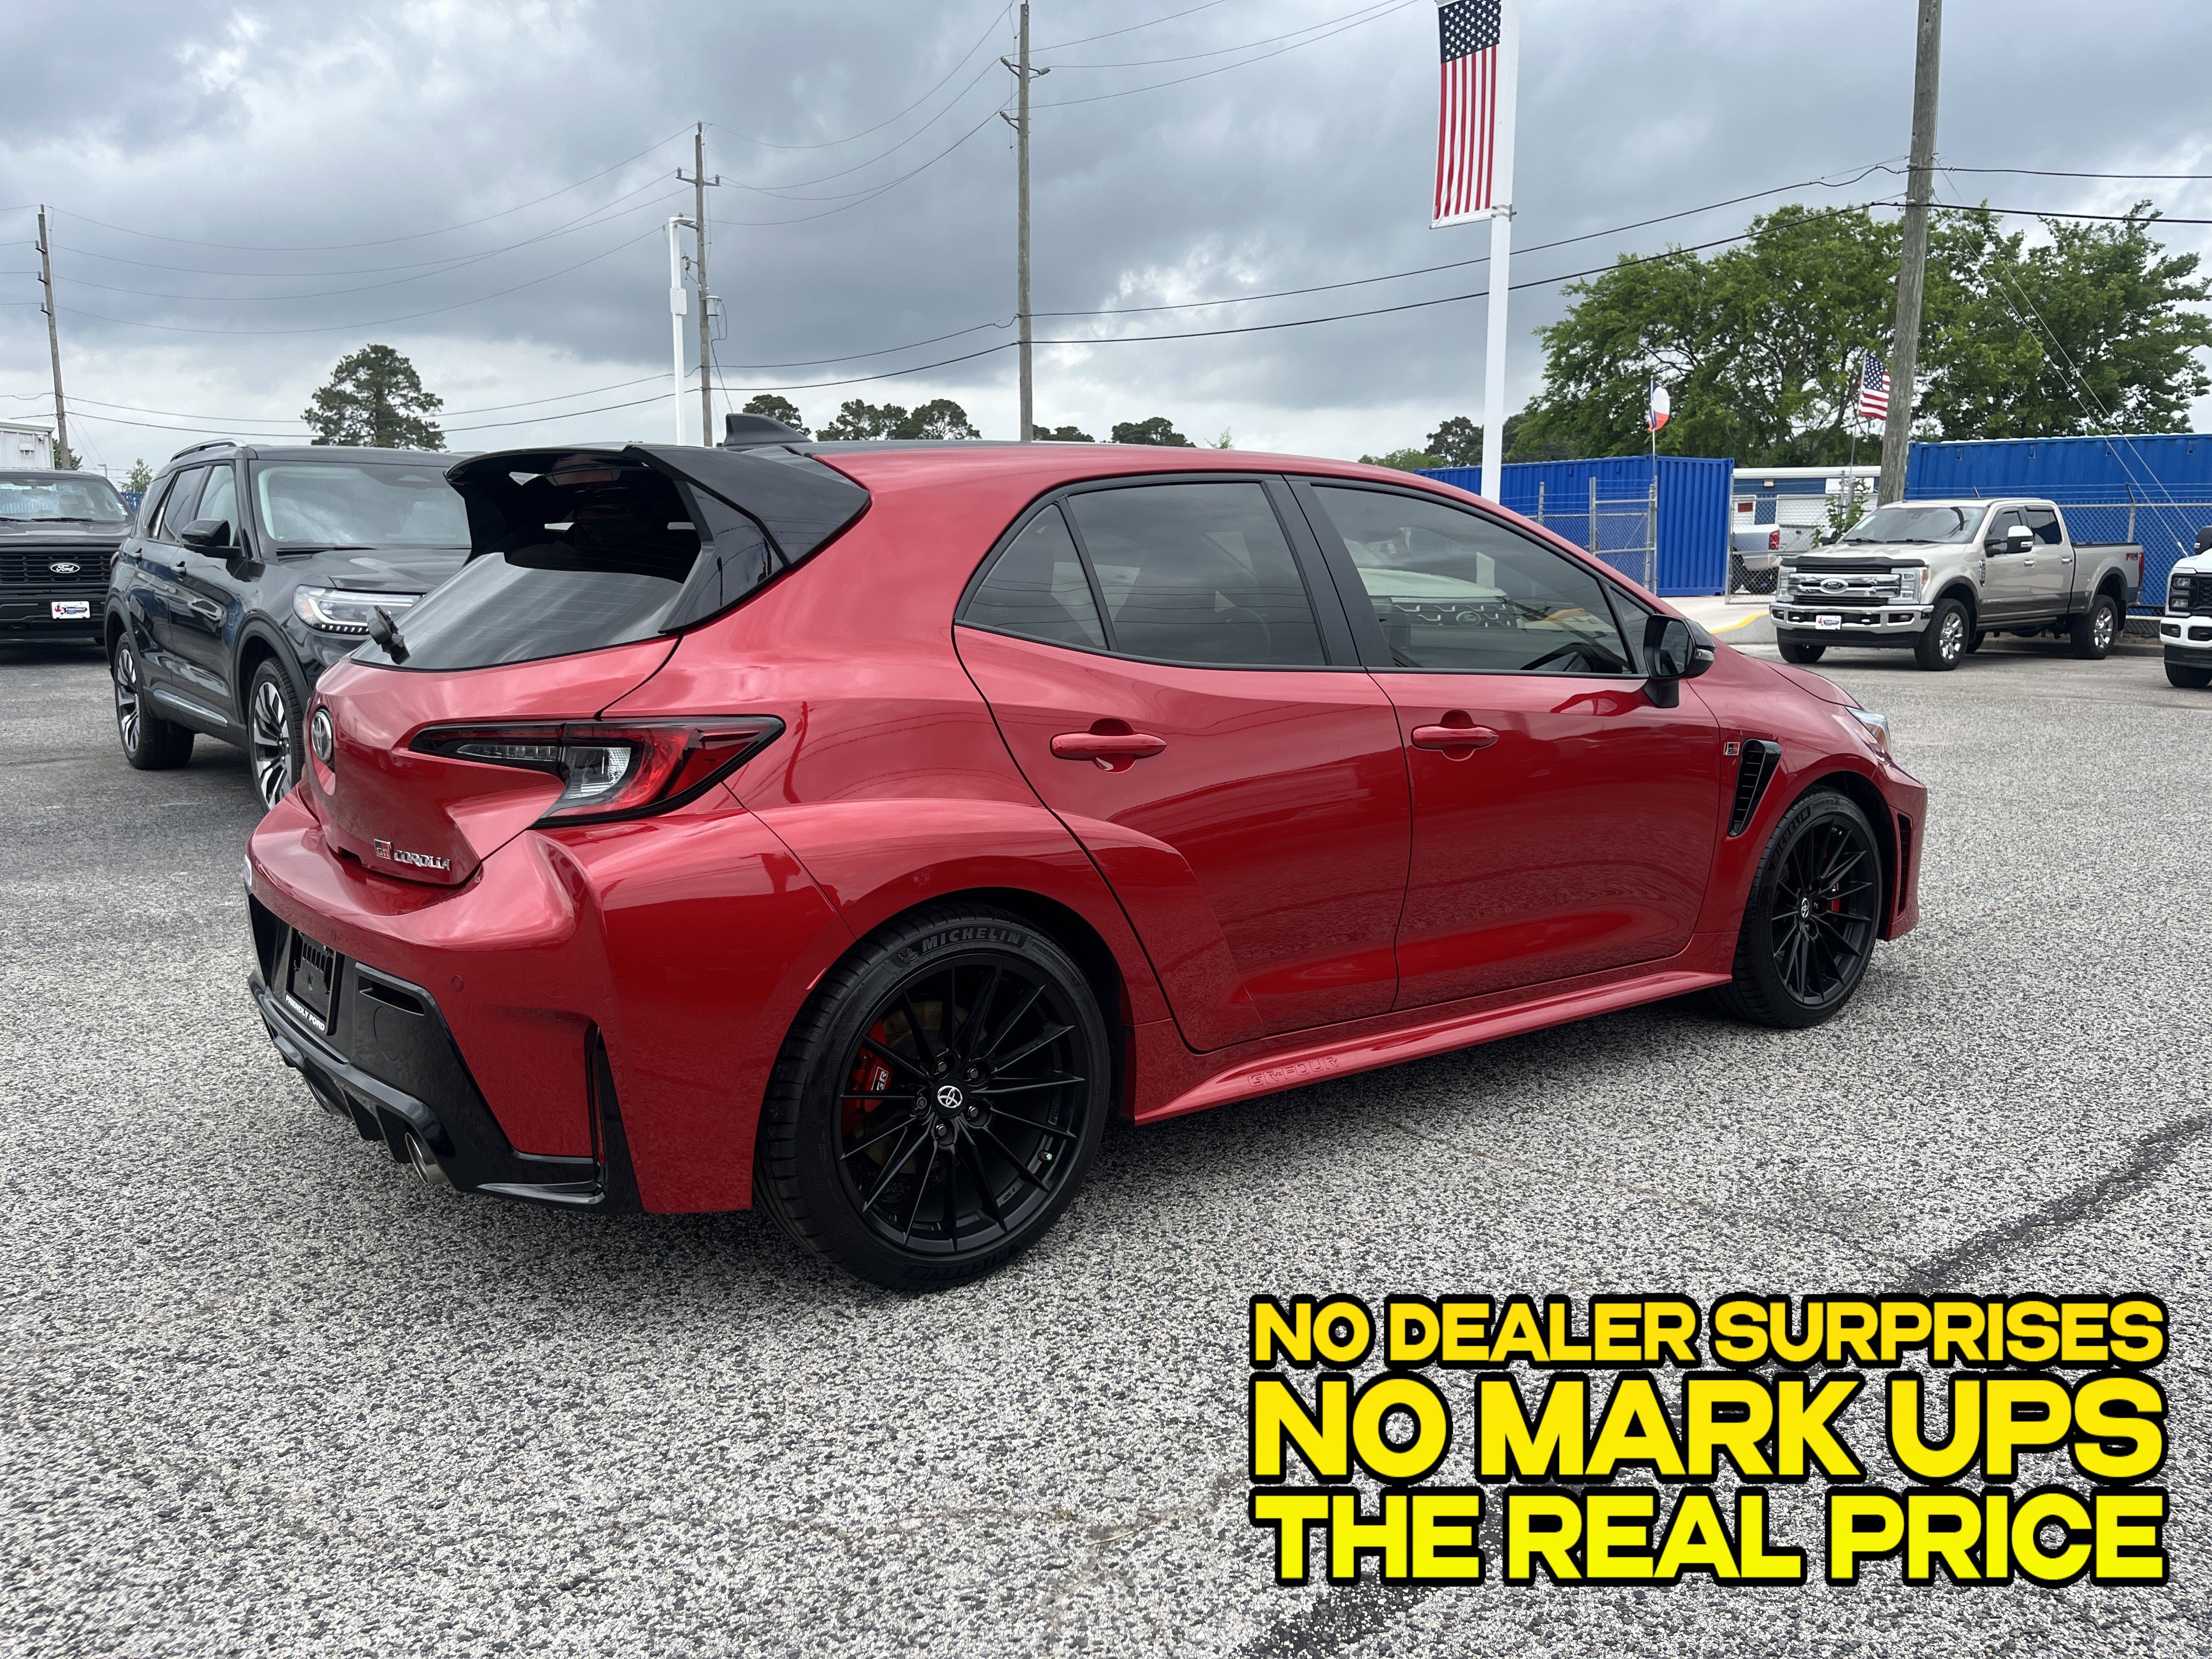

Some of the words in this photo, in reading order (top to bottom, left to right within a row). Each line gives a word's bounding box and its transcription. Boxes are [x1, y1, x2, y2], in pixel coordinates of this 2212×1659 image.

[1772, 809, 1809, 866] MICHELIN
[377, 847, 390, 857] GR
[393, 850, 450, 871] COROLLA
[922, 927, 1022, 952] MICHELIN
[286, 994, 309, 1019] FRIENDLY
[309, 1013, 325, 1031] FORD
[876, 1070, 888, 1091] GR
